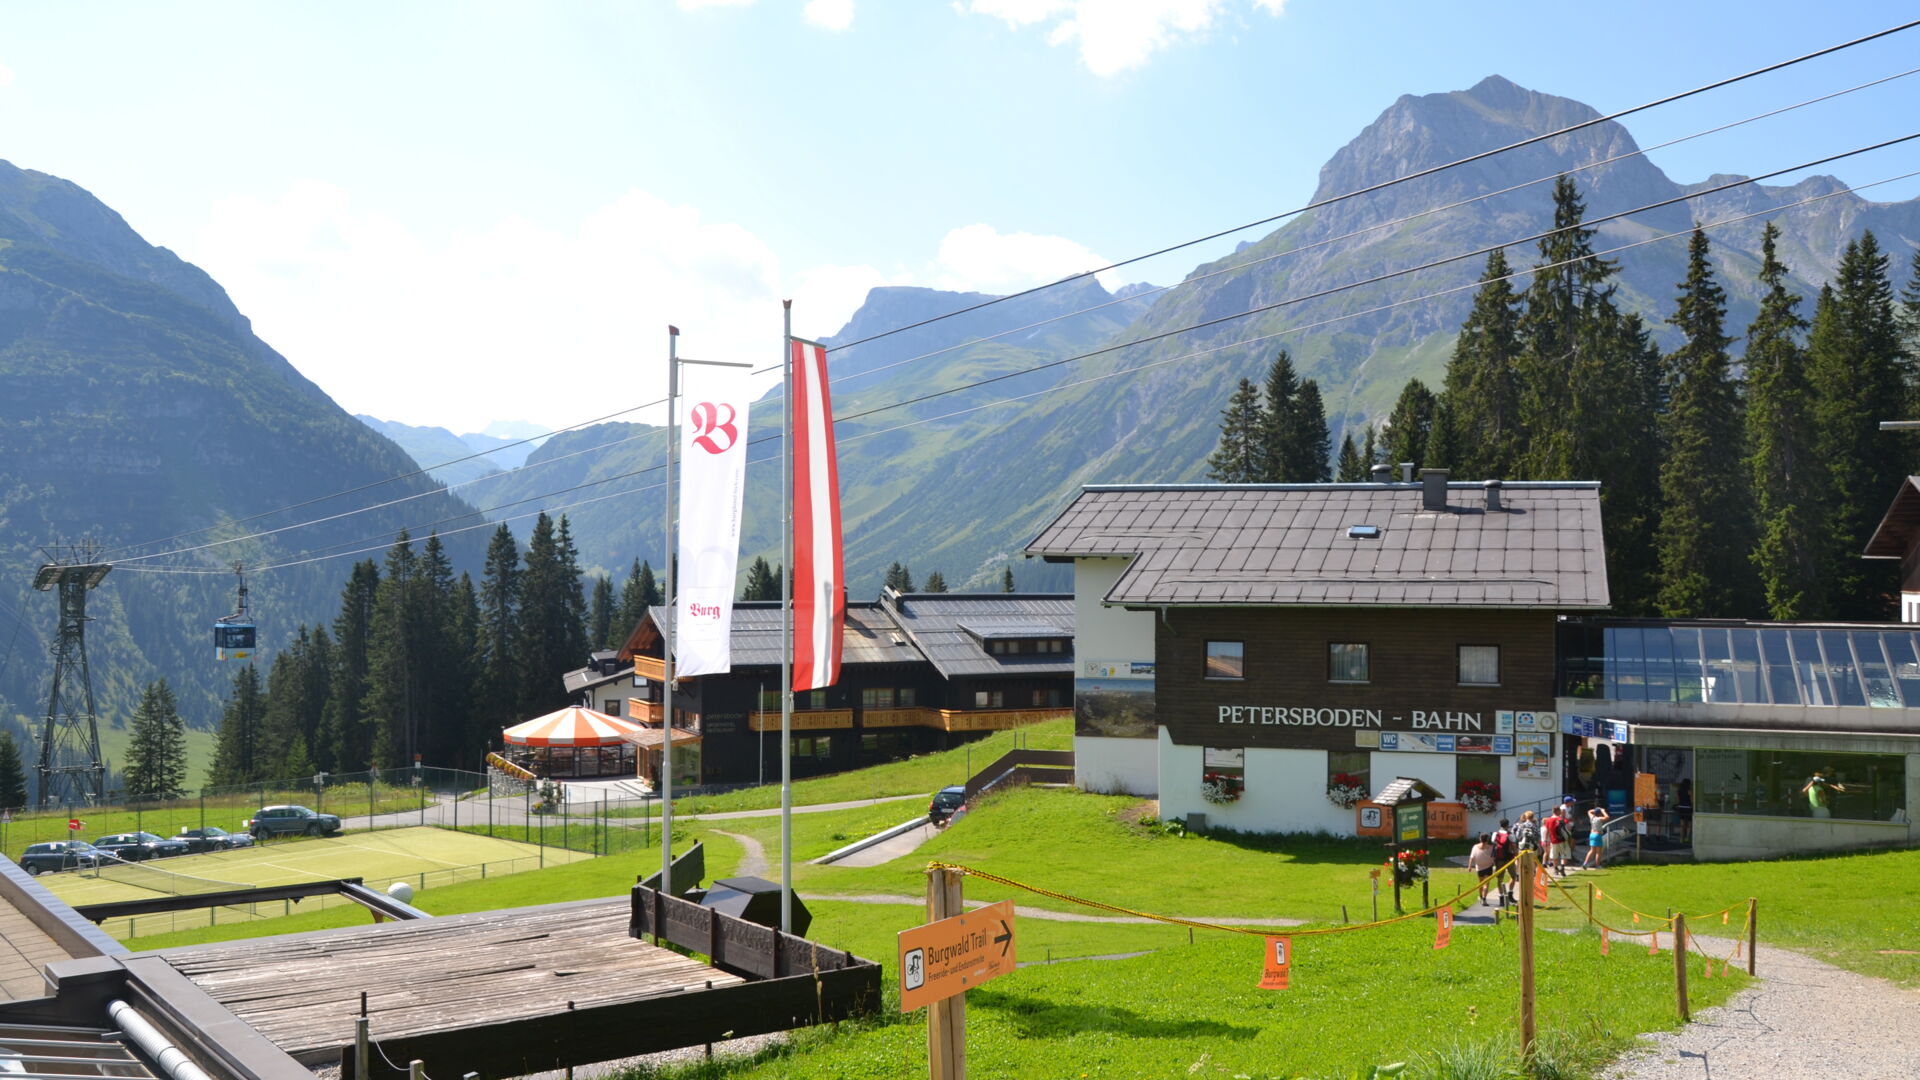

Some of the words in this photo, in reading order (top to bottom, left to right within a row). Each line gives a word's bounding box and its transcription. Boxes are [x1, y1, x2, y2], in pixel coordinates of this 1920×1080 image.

[691, 402, 738, 455] B
[690, 603, 721, 621] Burg
[1218, 705, 1382, 728] PETERSBODEN
[1411, 710, 1481, 731] BAHN
[1383, 734, 1396, 744] WC
[1440, 810, 1463, 821] Trail
[928, 934, 969, 966] Burgwald
[970, 928, 987, 949] Trail
